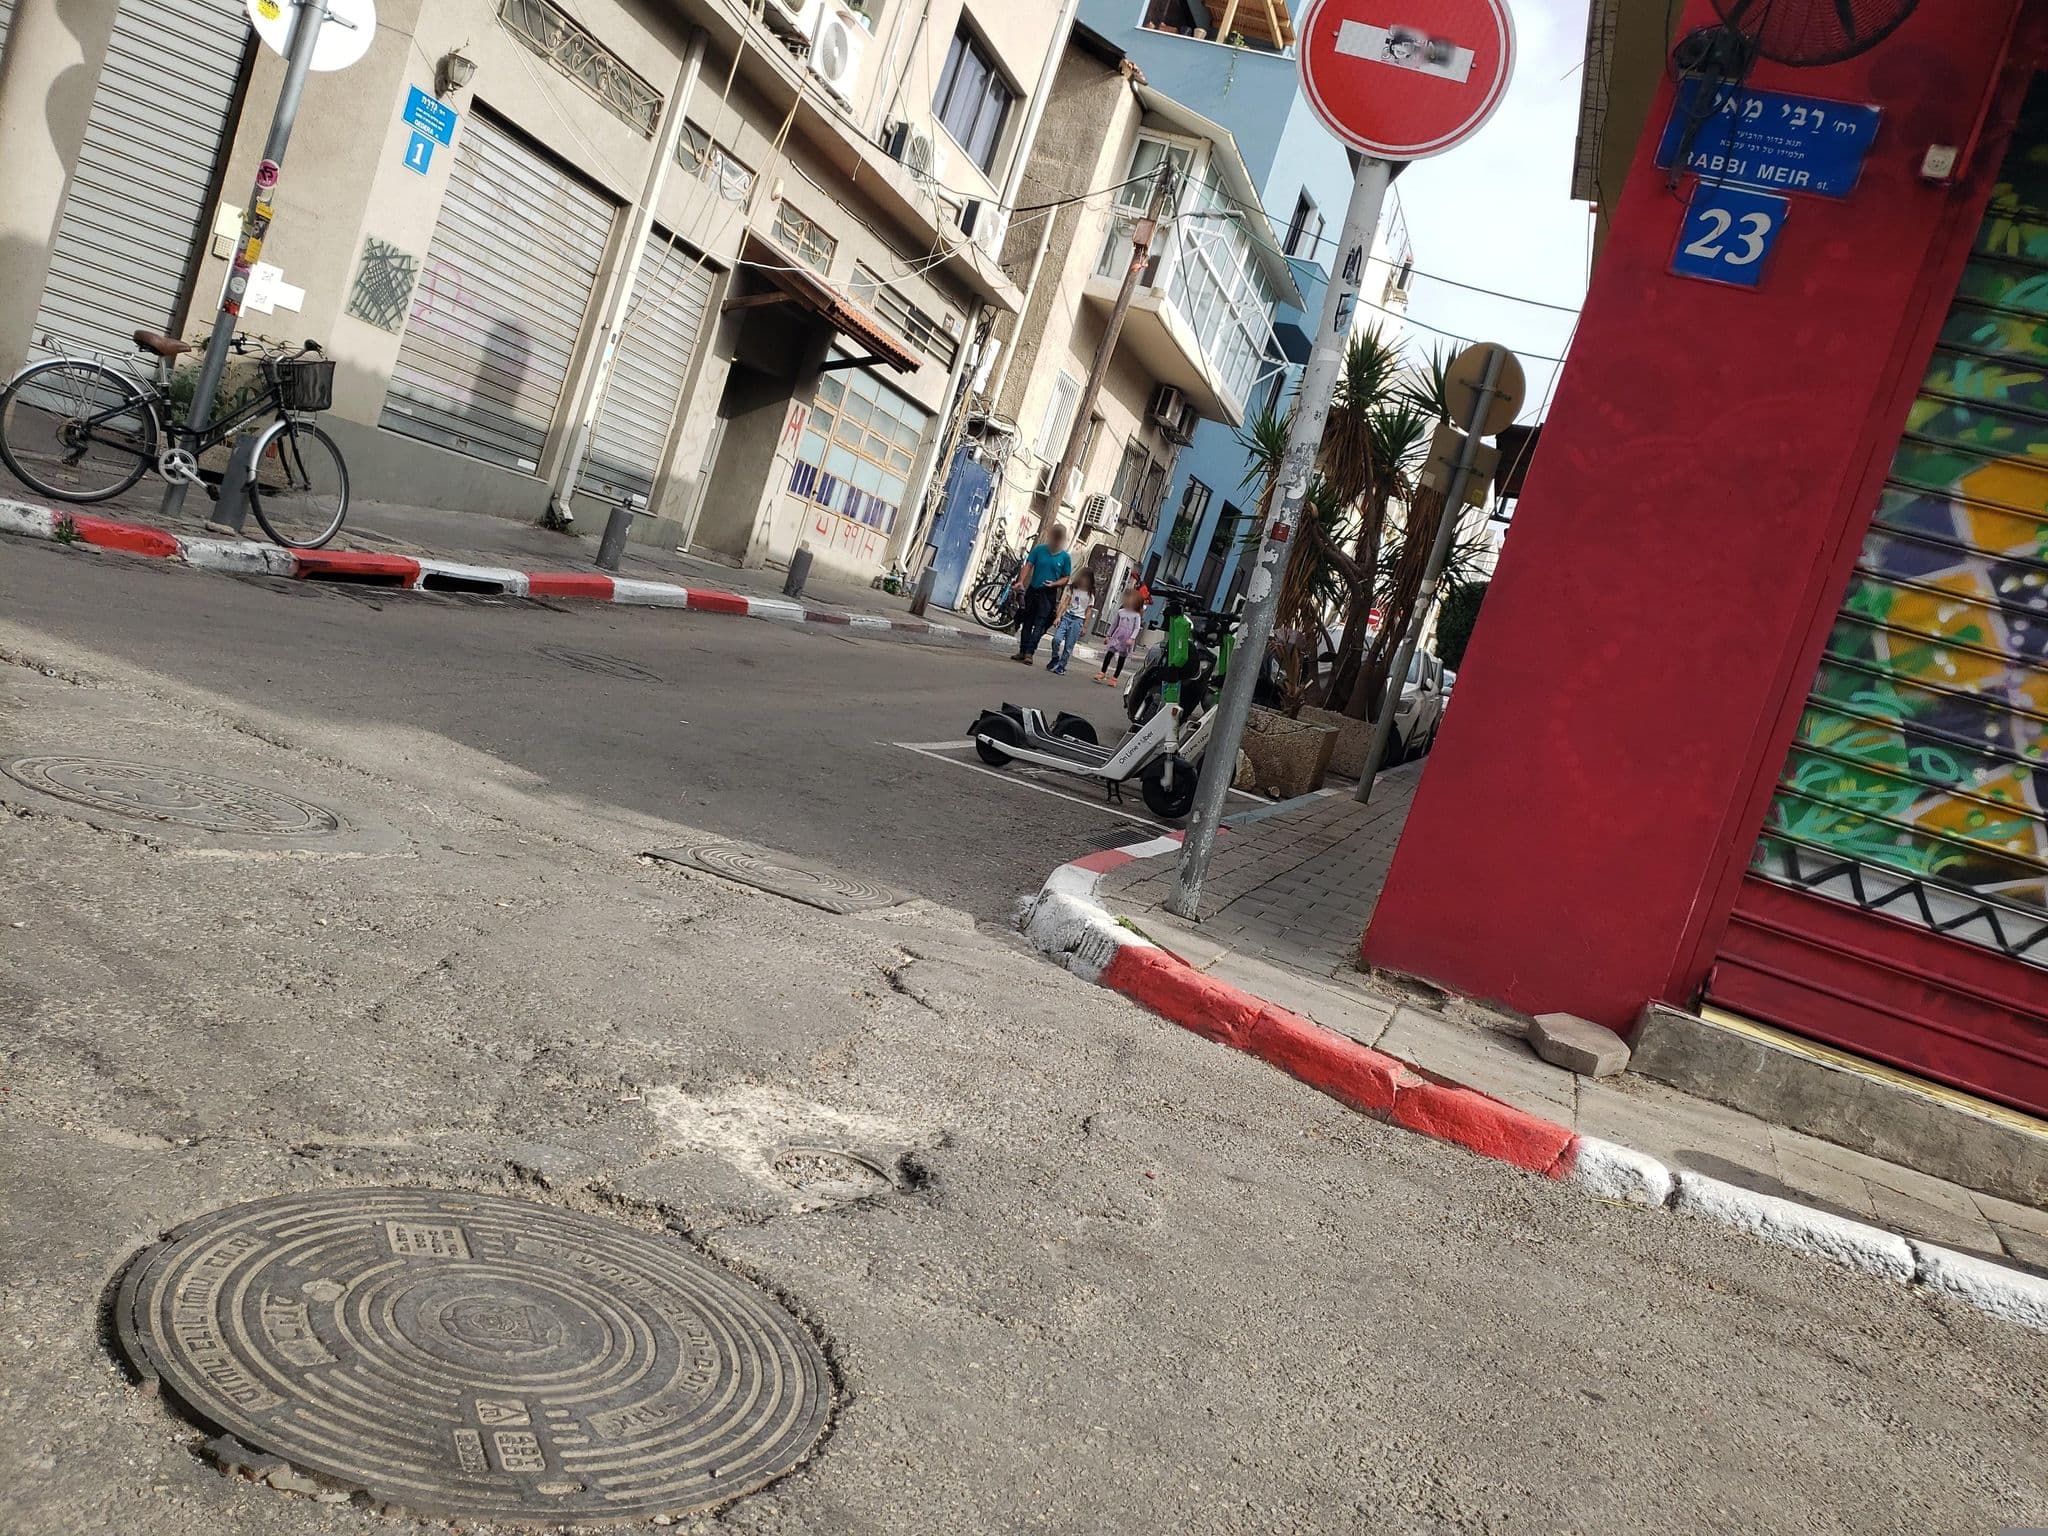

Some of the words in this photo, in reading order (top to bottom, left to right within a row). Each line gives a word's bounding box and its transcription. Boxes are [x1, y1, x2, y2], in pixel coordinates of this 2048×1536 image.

[412, 143, 425, 165] 1
[1719, 138, 1745, 151] עקבא
[1756, 163, 1811, 187] MEIR
[1684, 208, 1772, 265] 23
